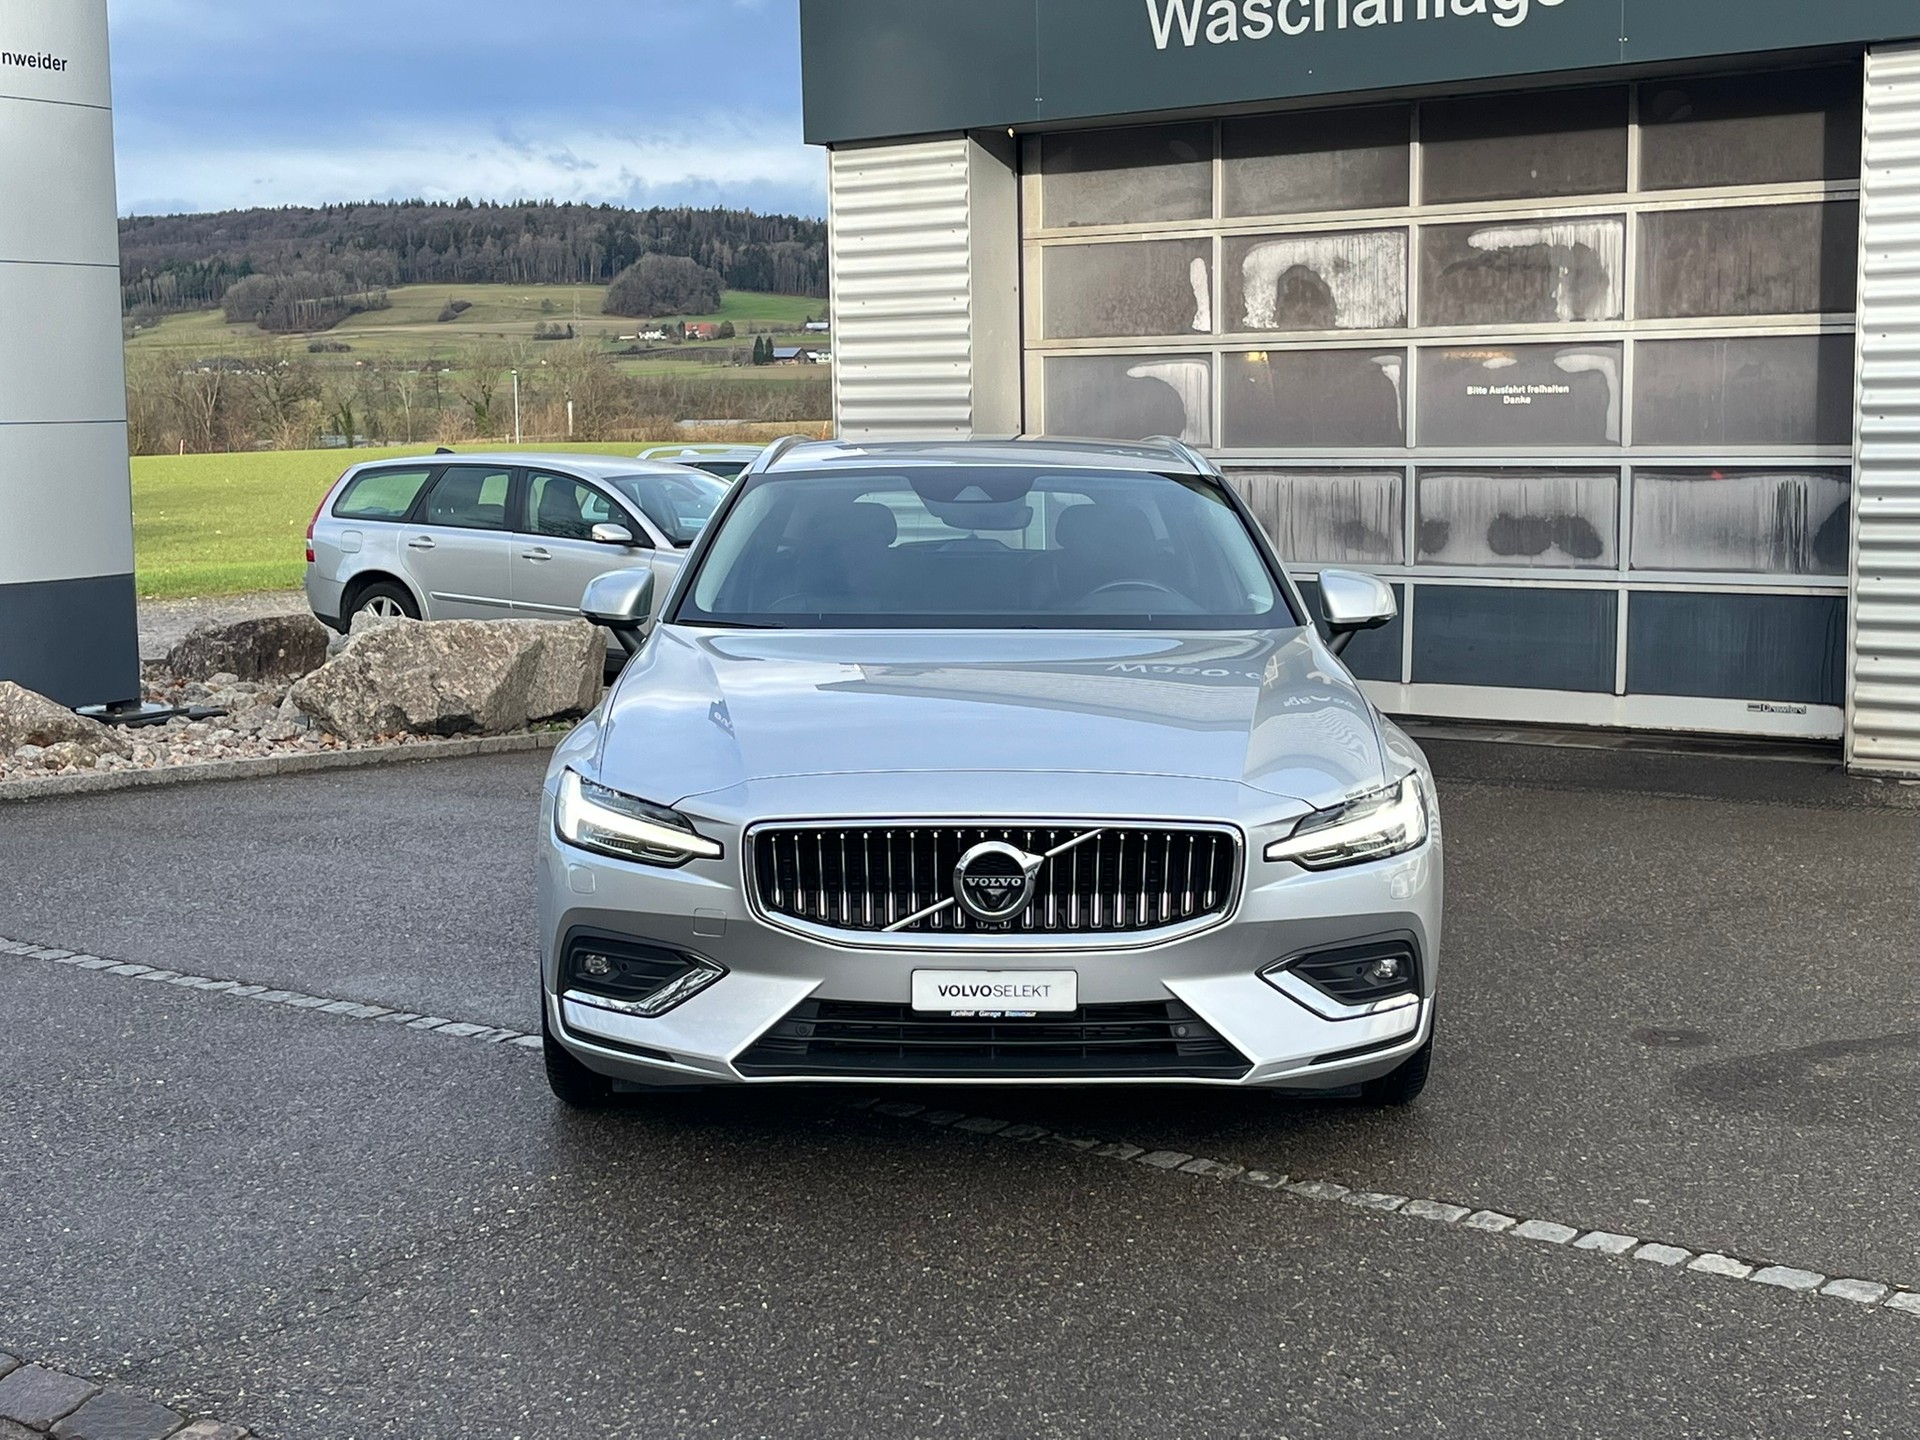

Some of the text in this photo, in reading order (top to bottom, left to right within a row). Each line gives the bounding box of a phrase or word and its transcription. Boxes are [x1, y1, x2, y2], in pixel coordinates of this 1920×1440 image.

[1146, 0, 1567, 49] Waschang
[1466, 384, 1570, 395] Bitte Ausfahrt freihalten
[1503, 395, 1531, 404] Danke
[965, 877, 1022, 887] VOLVO
[979, 1009, 1002, 1018] Garage
